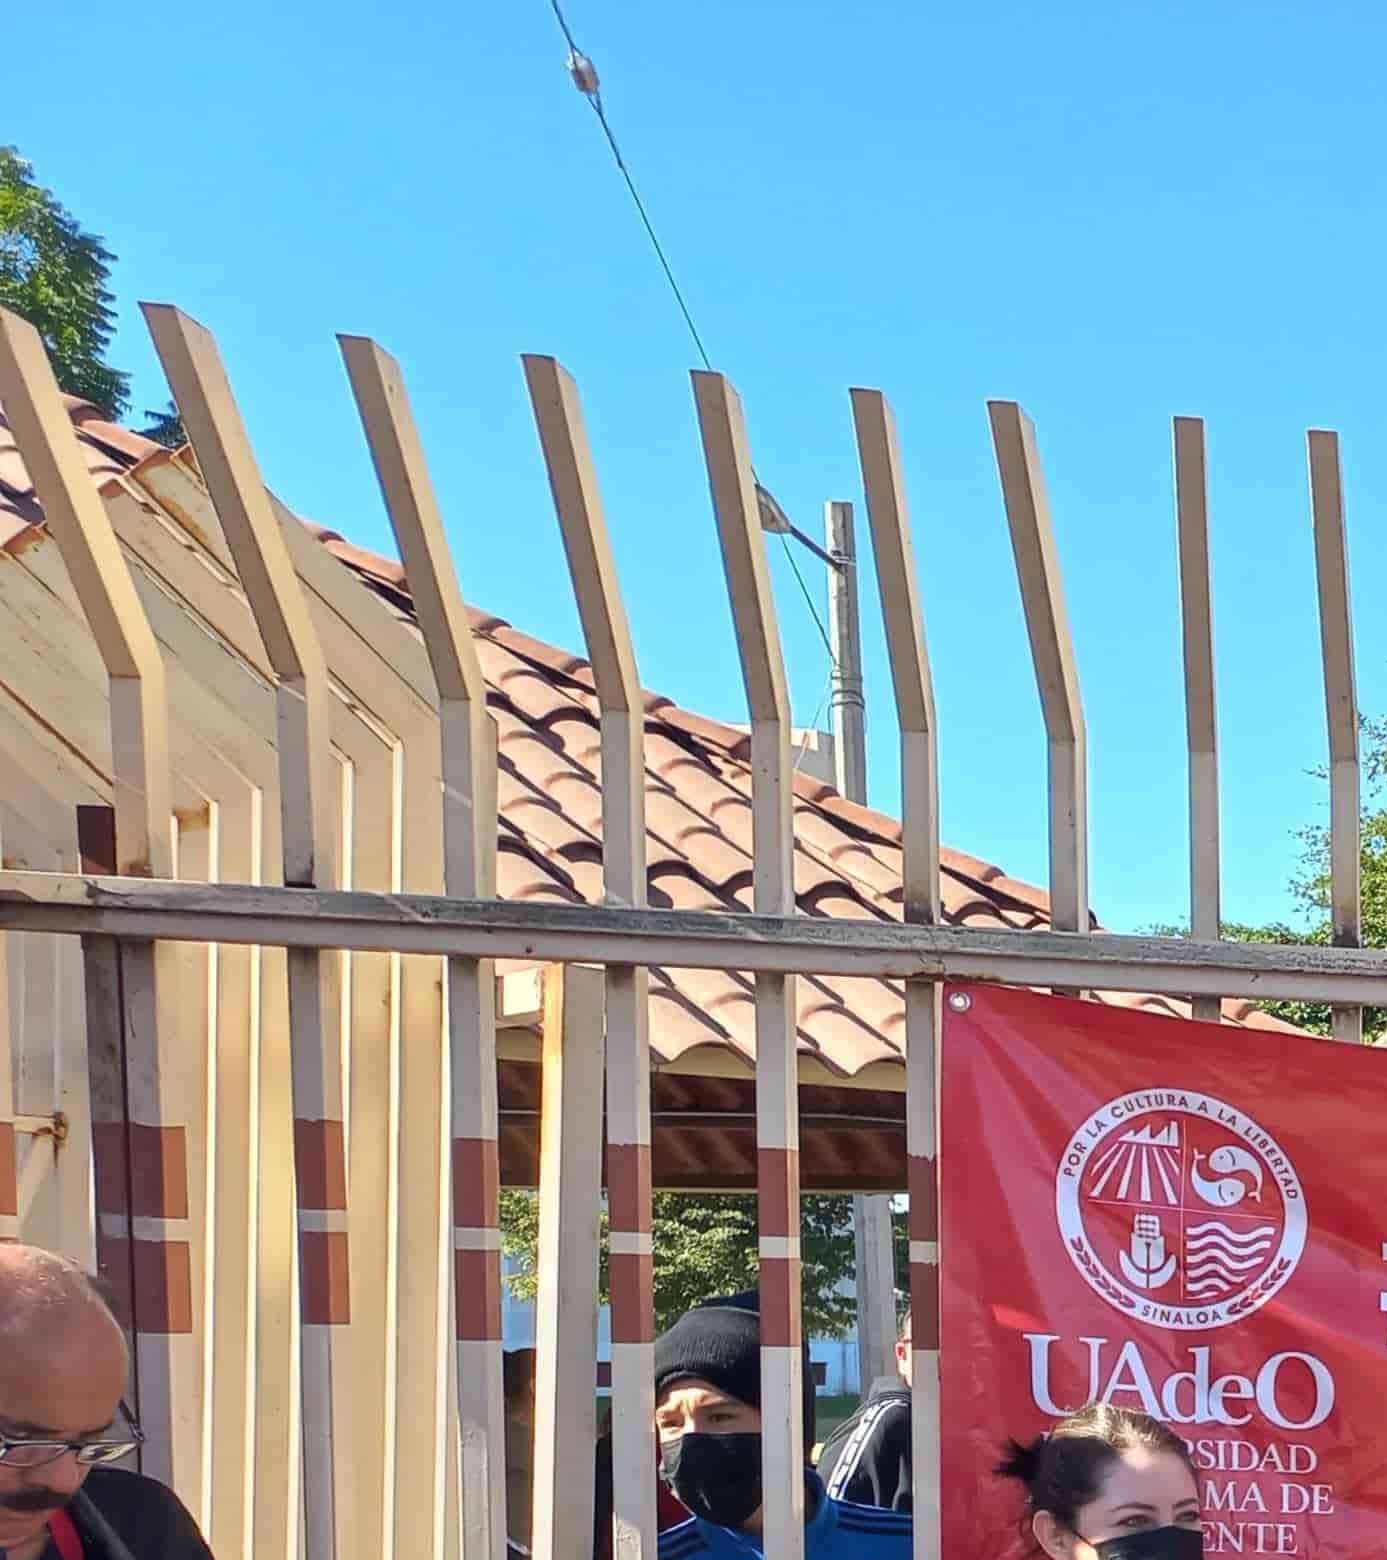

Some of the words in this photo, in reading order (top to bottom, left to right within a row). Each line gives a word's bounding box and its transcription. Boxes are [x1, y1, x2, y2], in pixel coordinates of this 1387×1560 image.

[1063, 1141, 1088, 1177] POR
[1086, 1119, 1107, 1138] LA
[1111, 1093, 1190, 1119] CULTURA
[1197, 1101, 1209, 1114] A
[1217, 1108, 1237, 1127] LA
[1244, 1126, 1299, 1200] LIBERTAD
[1141, 1304, 1222, 1325] SINALOA
[1022, 1333, 1335, 1430] UAdeO
[1280, 1482, 1335, 1515] DE
